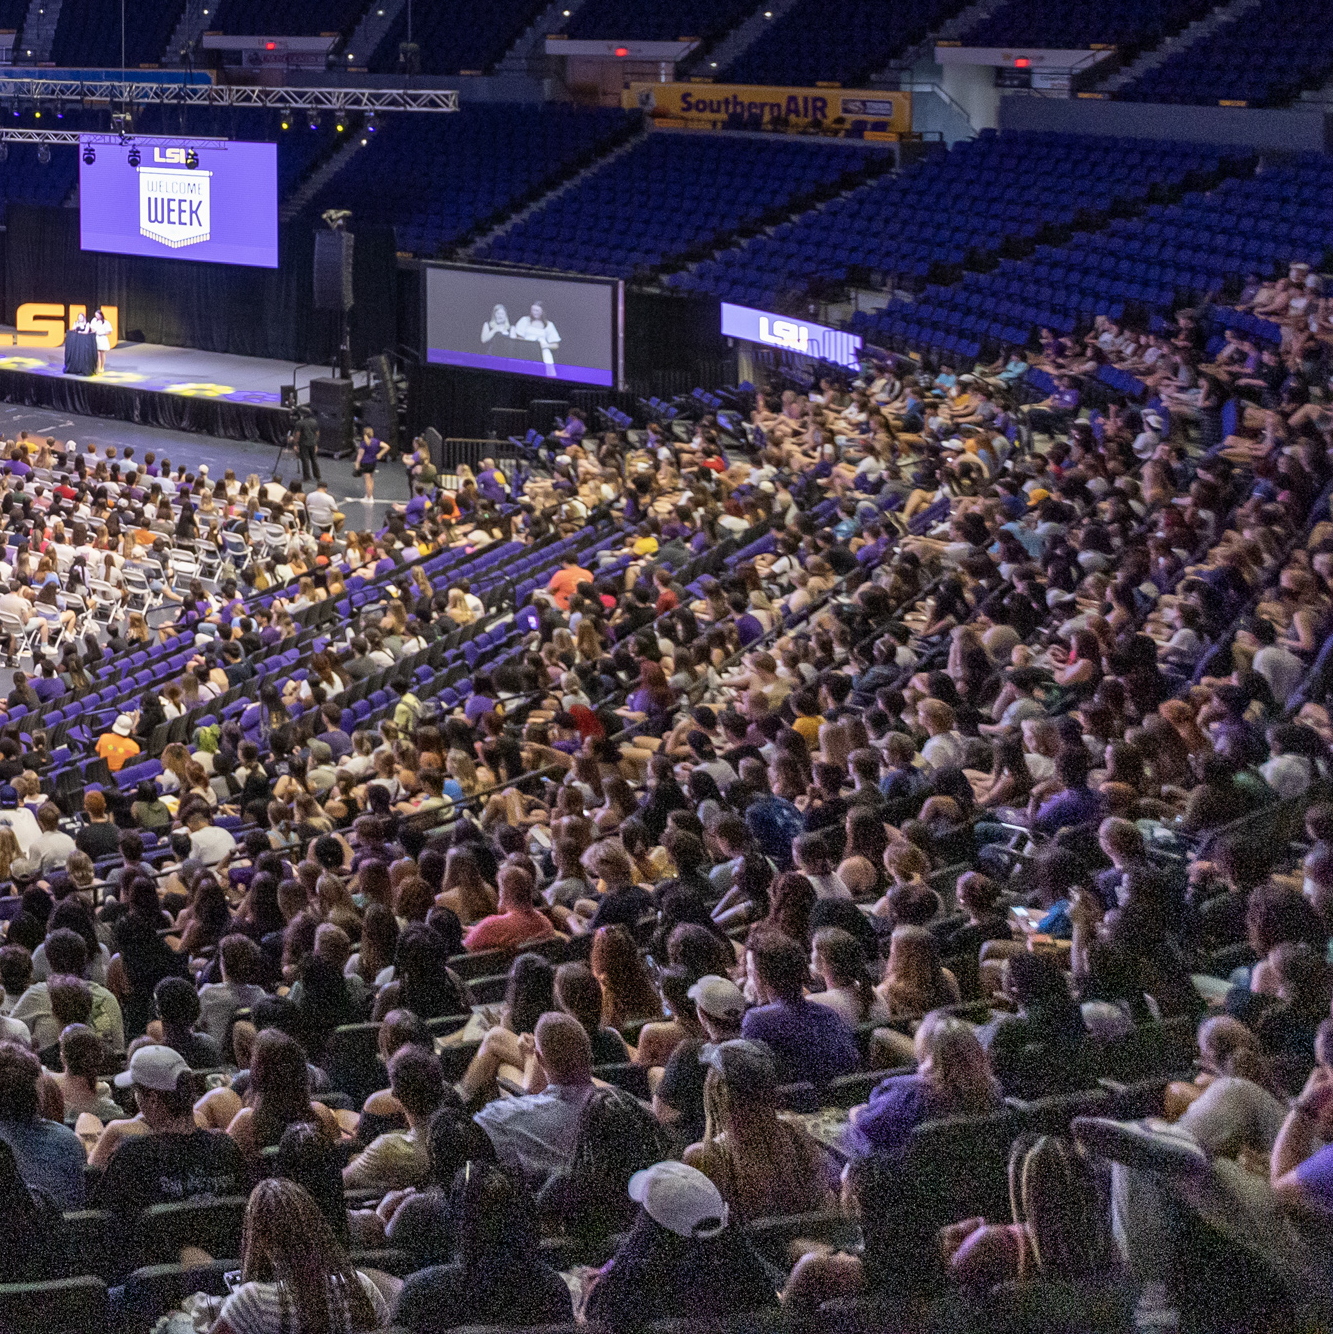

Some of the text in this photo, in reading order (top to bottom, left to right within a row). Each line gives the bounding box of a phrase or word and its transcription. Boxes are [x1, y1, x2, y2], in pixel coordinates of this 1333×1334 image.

[147, 180, 202, 195] WELCOME
[148, 197, 202, 227] WEEK
[759, 317, 808, 352] LSU
